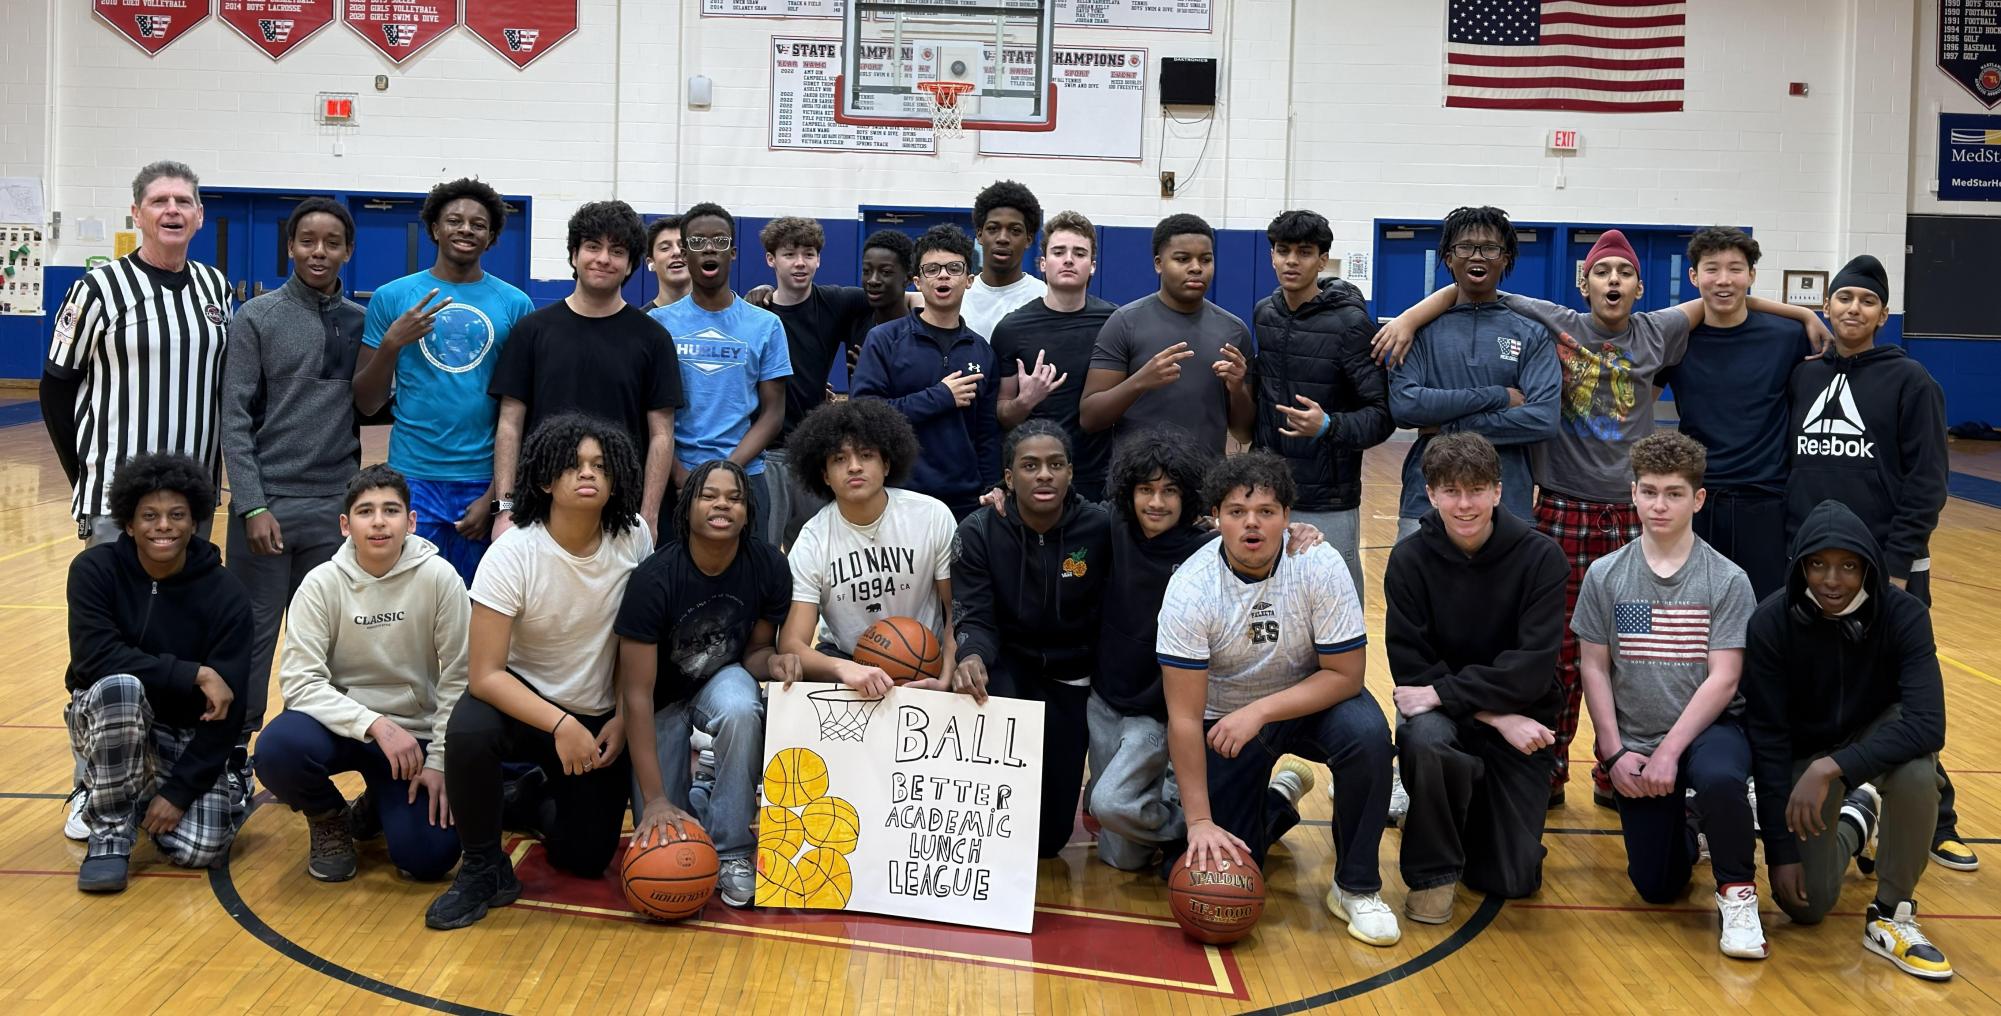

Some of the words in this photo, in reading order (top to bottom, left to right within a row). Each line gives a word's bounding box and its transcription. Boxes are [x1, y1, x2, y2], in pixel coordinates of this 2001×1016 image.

[143, 0, 187, 8] VOLLEYBALL
[392, 5, 438, 14] VOLLEYBALL
[1944, 8, 1961, 16] 1990
[1964, 8, 1998, 17] FOOTBALL
[1944, 17, 1960, 25] 1991
[1964, 18, 1998, 26] FOOTBALL
[1944, 26, 1960, 34] 1994
[792, 43, 836, 58] STATE
[1943, 52, 1959, 60] 1997
[1963, 44, 1997, 52] BASEBALL
[776, 60, 799, 68] YEAR
[802, 61, 827, 69] NAME
[1053, 51, 1126, 68] HAMPIONS
[1063, 69, 1091, 77] SPORT
[1110, 71, 1138, 79] EVENT
[1555, 130, 1577, 148] EXIT
[1951, 148, 2001, 163] MedSt
[676, 343, 743, 360] HURLEY
[1797, 435, 1875, 459] Reebok
[863, 546, 915, 575] NAVY
[850, 575, 896, 603] 1994
[900, 583, 911, 591] CA
[353, 611, 405, 626] CLASSIC
[1251, 620, 1280, 645] ES
[895, 705, 1027, 768] B.A.L.L.
[892, 772, 1012, 810] BETTER
[909, 832, 982, 865] LUNCH
[889, 860, 990, 901] LEAGUE
[1189, 870, 1255, 894] SPALDING
